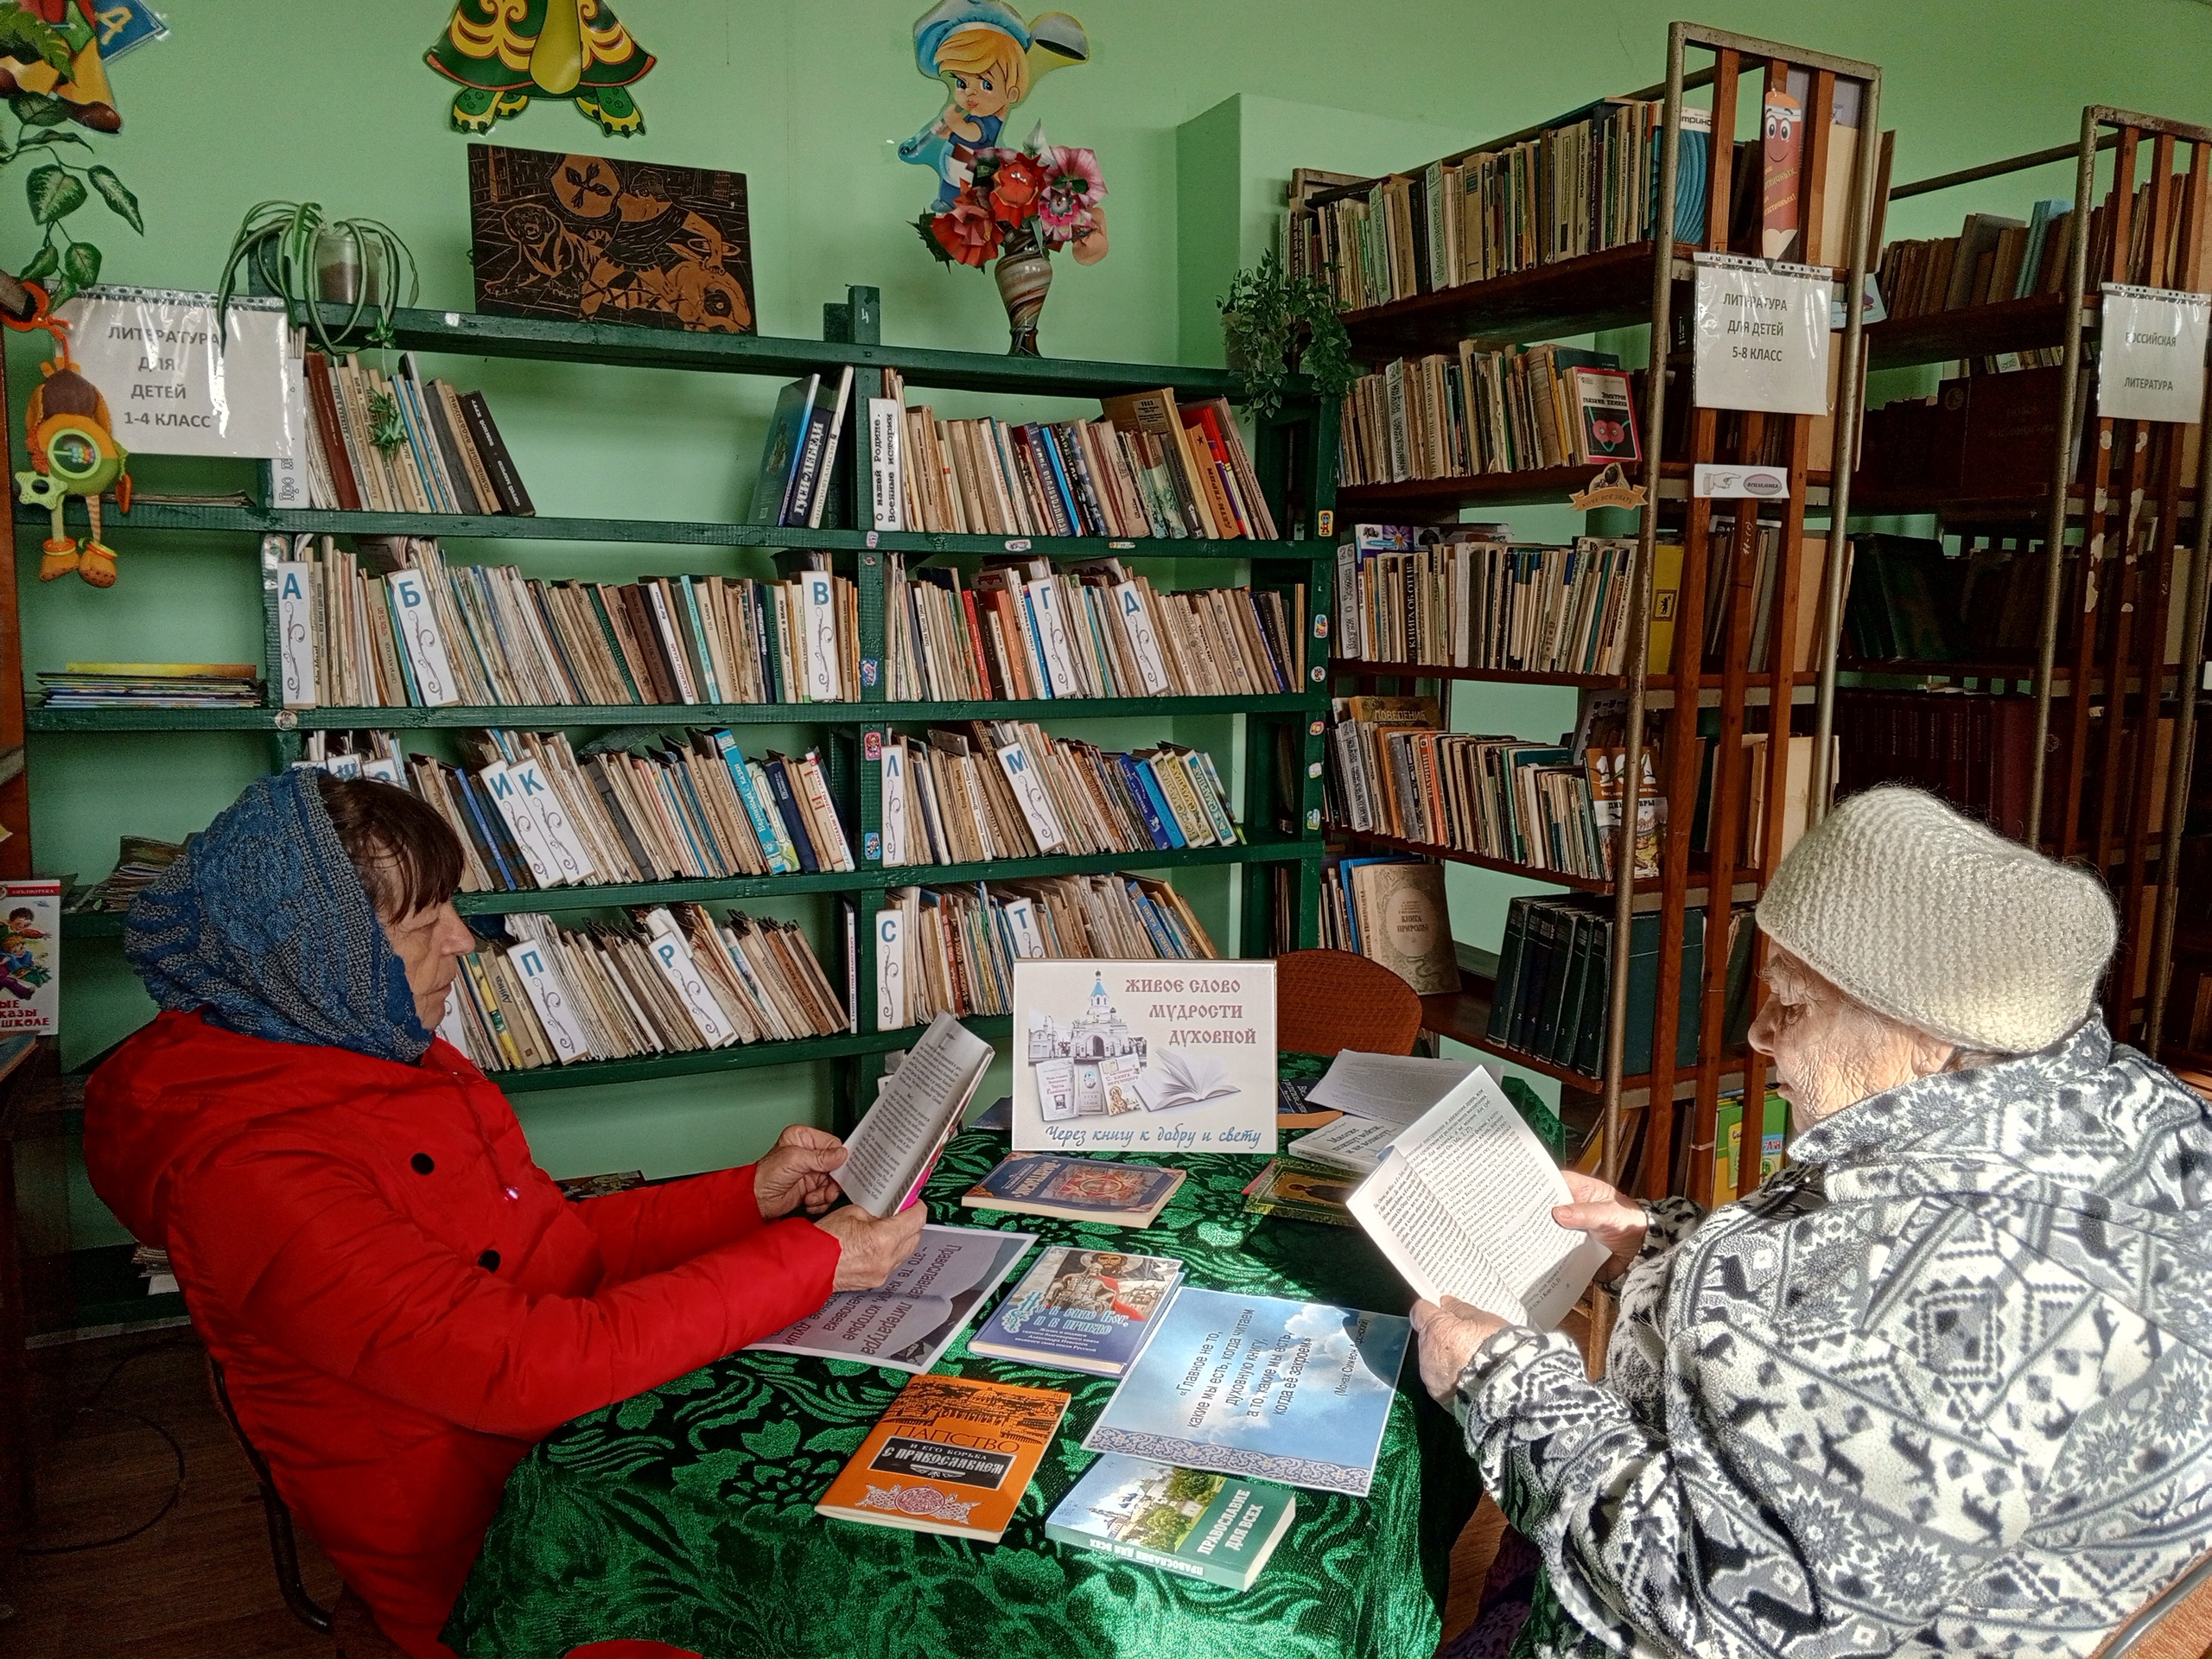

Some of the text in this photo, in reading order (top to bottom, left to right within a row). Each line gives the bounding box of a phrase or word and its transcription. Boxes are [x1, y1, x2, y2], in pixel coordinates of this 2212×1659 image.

[1723, 293, 1788, 311] ЛИТЕРАТУРА
[108, 326, 220, 345] ЛИТЕРАТУРА
[1727, 320, 1783, 336] ДЛЯ ДЕТЕЙ
[1732, 346, 1783, 361] 5-8 КЛАСС
[130, 384, 187, 399] ДЕТЕЙ
[2125, 378, 2173, 391] ЛИТЕРАТУРА
[124, 411, 211, 428] 1-4 КЛАСС
[792, 421, 825, 516] ГУСИ-ЛЕБЕДИ
[874, 413, 884, 522] О нашей Родине.
[886, 413, 897, 523] Военные истории
[282, 572, 302, 600] А
[397, 580, 422, 608] Б
[812, 581, 830, 606] В
[1040, 586, 1052, 610] Г
[1122, 590, 1141, 617] Д
[1407, 594, 1414, 609] ОБ
[1407, 611, 1415, 647] КНИГА
[886, 754, 899, 778] Л
[1005, 749, 1029, 775] М
[488, 772, 514, 801] И
[518, 767, 545, 797] К
[881, 919, 897, 943] С
[1014, 907, 1027, 930] Т
[1397, 925, 1429, 933] ПРИРОДЫ
[520, 950, 544, 977] П
[658, 944, 676, 969] Р
[1125, 978, 1241, 994] ЖИВОЕ СЛОВО
[1148, 1003, 1243, 1021] МУДРОСТИ
[1168, 1027, 1257, 1048] ДУХОВНОЙ
[1044, 1122, 1262, 1150] Через книгу к добру и свету
[913, 1252, 927, 1266] это
[897, 1268, 913, 1278] те
[907, 1244, 962, 1300] Православная
[822, 1294, 865, 1332] человека
[842, 1304, 881, 1341] которые
[782, 1322, 811, 1346] души
[861, 1302, 912, 1356] литература
[1274, 1332, 1296, 1354] есть,
[1176, 1330, 1223, 1396] «Главное не то,
[1187, 1308, 1255, 1428] какие мы есть, когда читаем
[1225, 1338, 1268, 1406] духовную книгу,
[1268, 1352, 1282, 1368] мы
[1257, 1368, 1277, 1395] какие
[1273, 1337, 1314, 1416] когда её закроем»
[1251, 1395, 1268, 1410] то,
[893, 1425, 1020, 1453] ПАПСТВО
[881, 1446, 1005, 1476] С ПРАВОСЛАВИЕМ
[922, 1445, 944, 1454] ЕГО
[947, 1449, 988, 1461] БОРЬБА
[1197, 1489, 1251, 1554] ПРАВОСЛАВИЕ
[1224, 1504, 1264, 1551] ДЛЯ ВСЕХ
[1089, 1538, 1114, 1554] ВСЕХ
[1136, 1549, 1205, 1576] ПРАВОСЛАВИЕ
